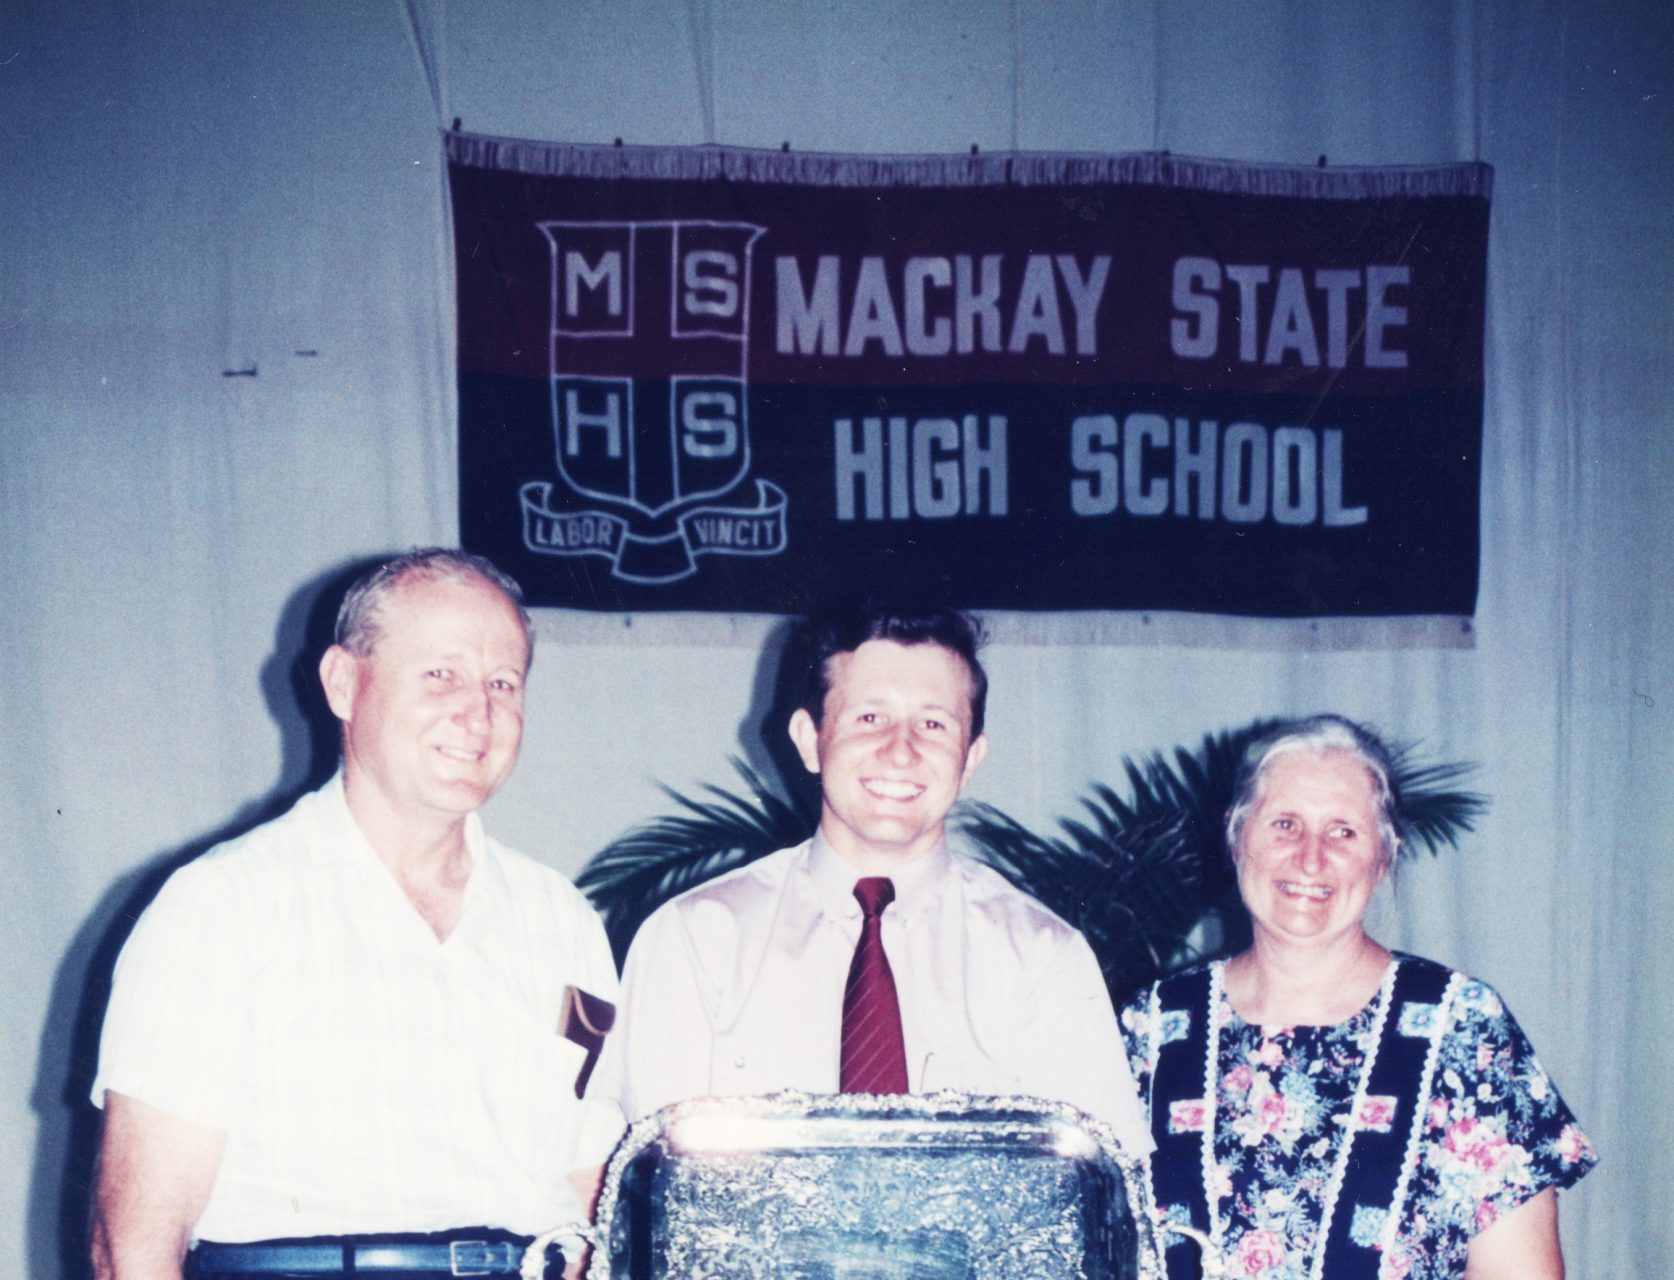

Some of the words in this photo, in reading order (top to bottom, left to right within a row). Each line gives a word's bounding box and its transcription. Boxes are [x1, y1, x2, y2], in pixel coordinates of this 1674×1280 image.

[565, 251, 622, 316] M
[683, 251, 739, 317] S
[775, 254, 1112, 357] MACKAY
[1170, 256, 1411, 369] STATE
[565, 390, 622, 459] H
[682, 390, 738, 458] S
[834, 415, 1009, 521] HIGH
[1070, 413, 1368, 528] SCHOOL
[535, 518, 613, 547] LABOR
[694, 518, 776, 546] VINCIT
